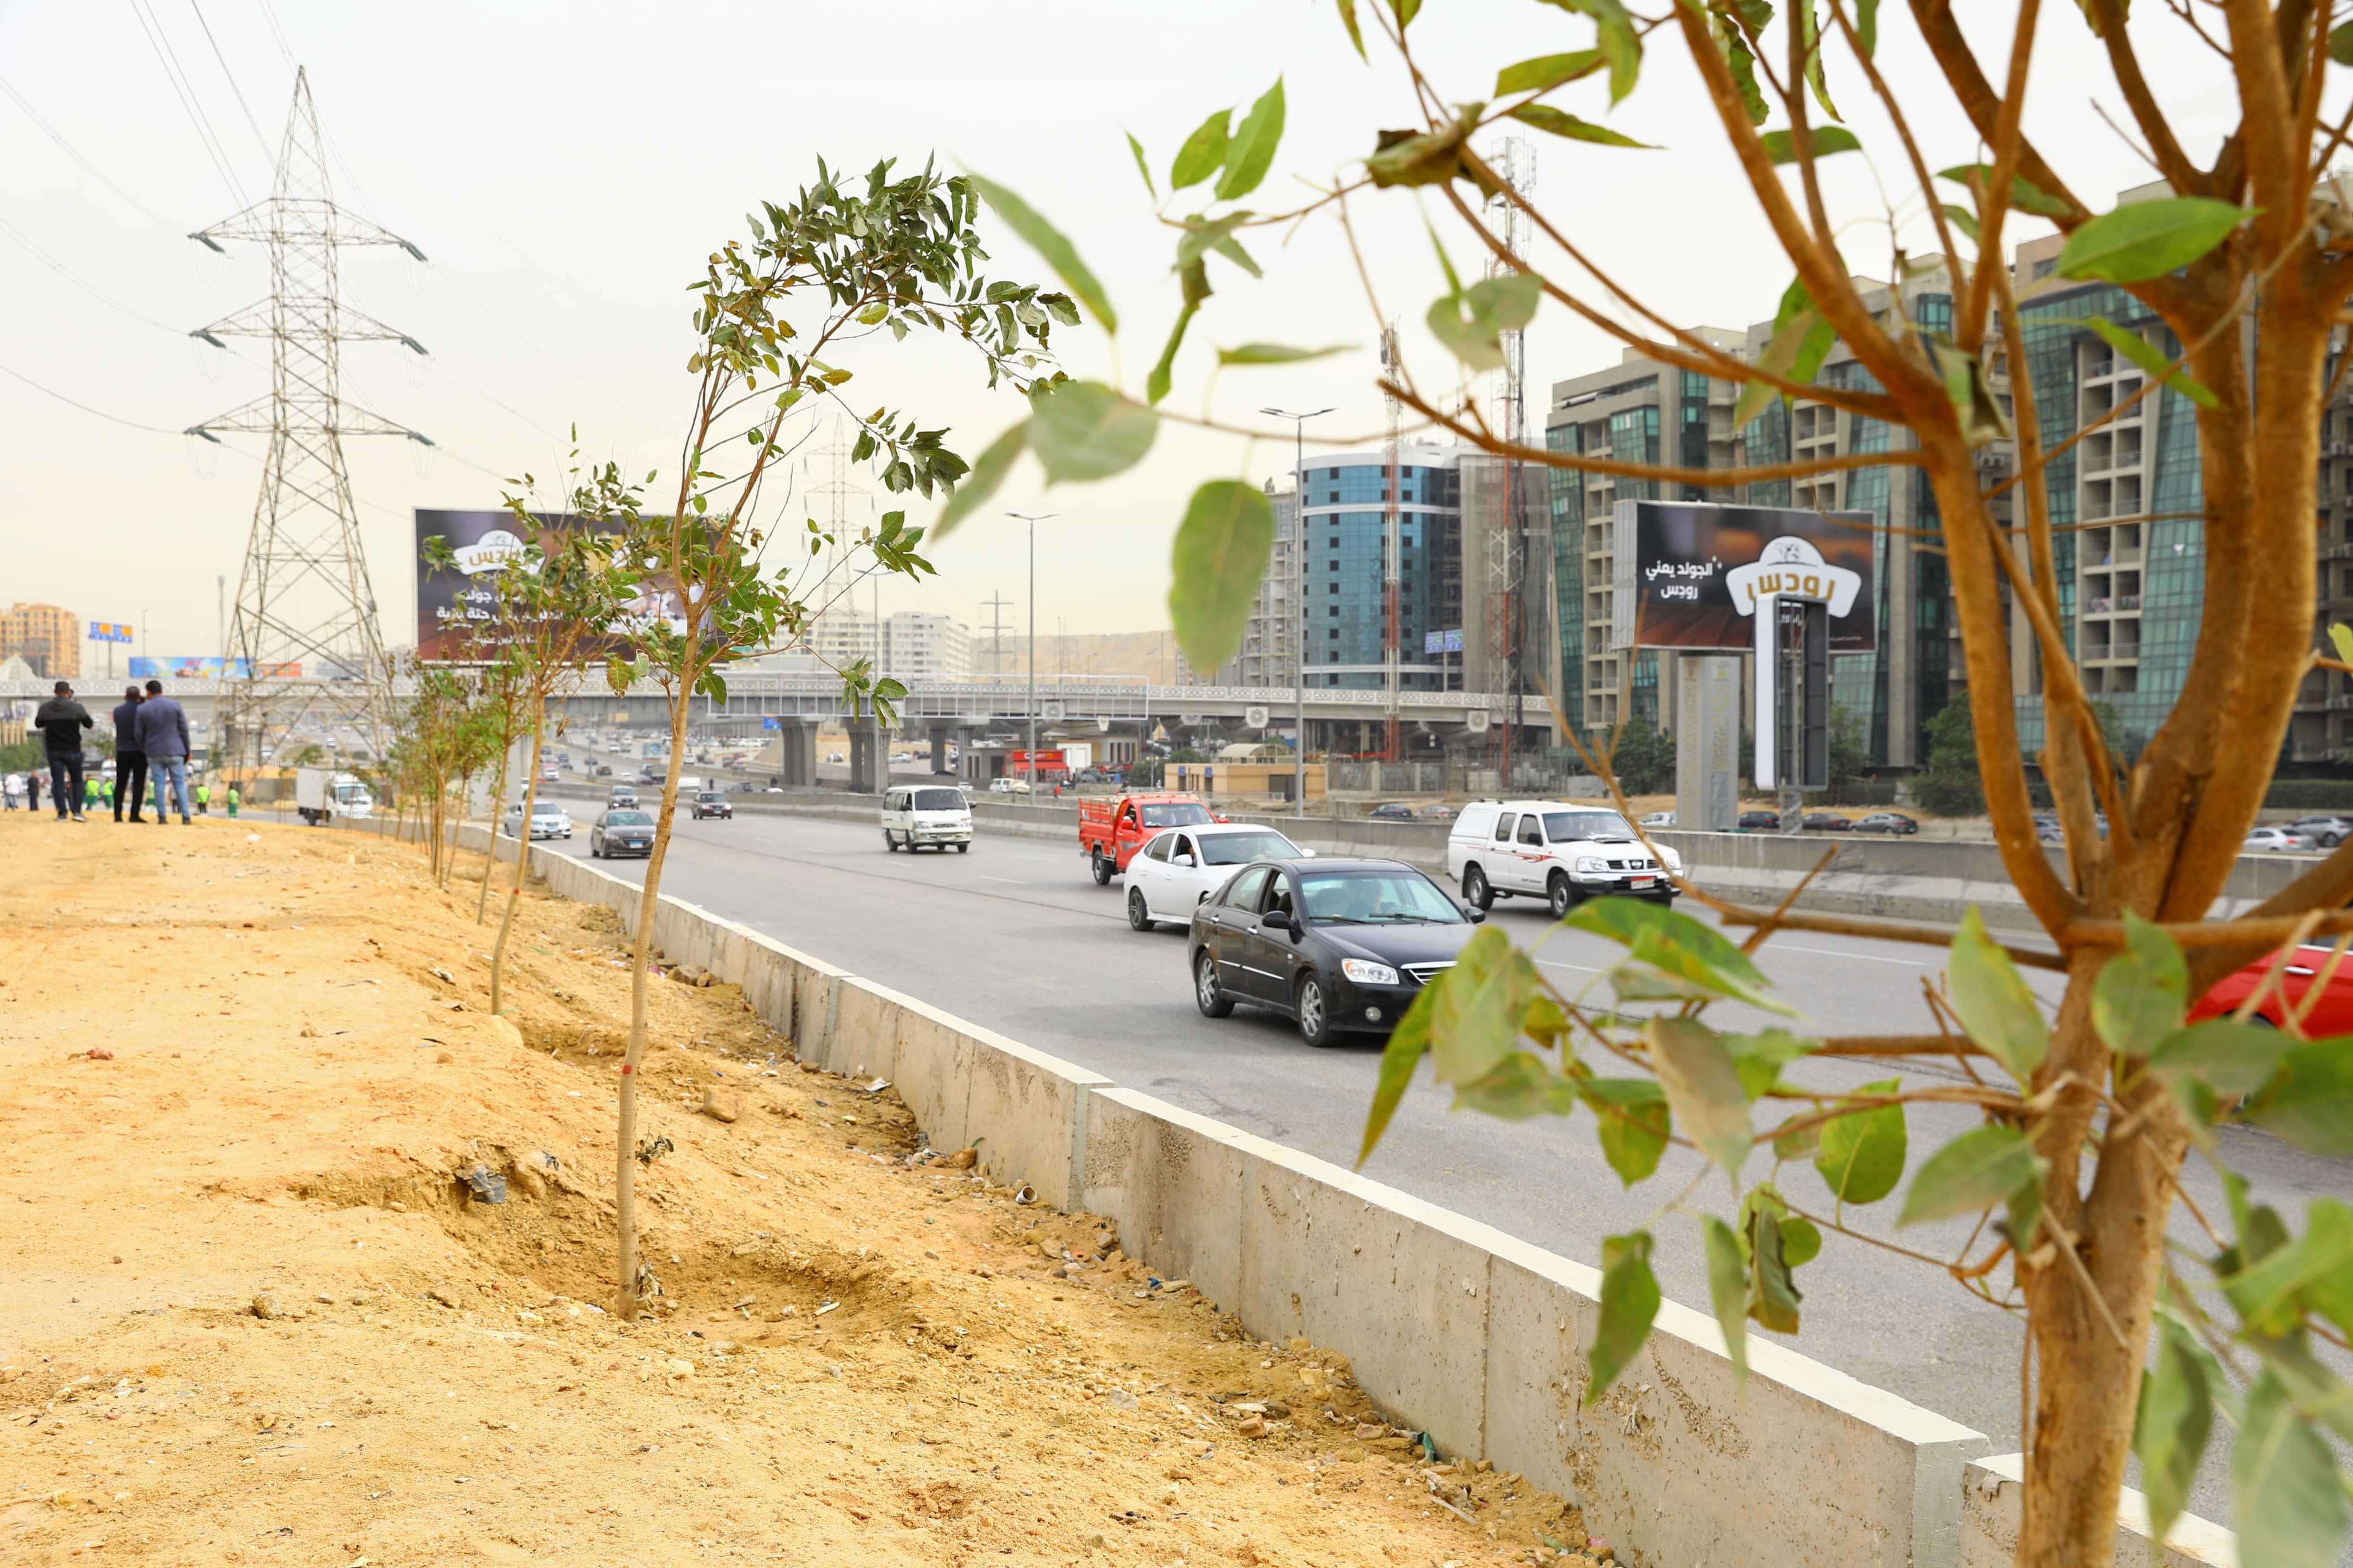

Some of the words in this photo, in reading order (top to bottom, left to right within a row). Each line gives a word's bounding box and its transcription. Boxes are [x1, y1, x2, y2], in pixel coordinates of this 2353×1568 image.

[1645, 560, 1676, 581] يعني
[1677, 561, 1713, 580] الجولد
[1746, 573, 1836, 602] رودس
